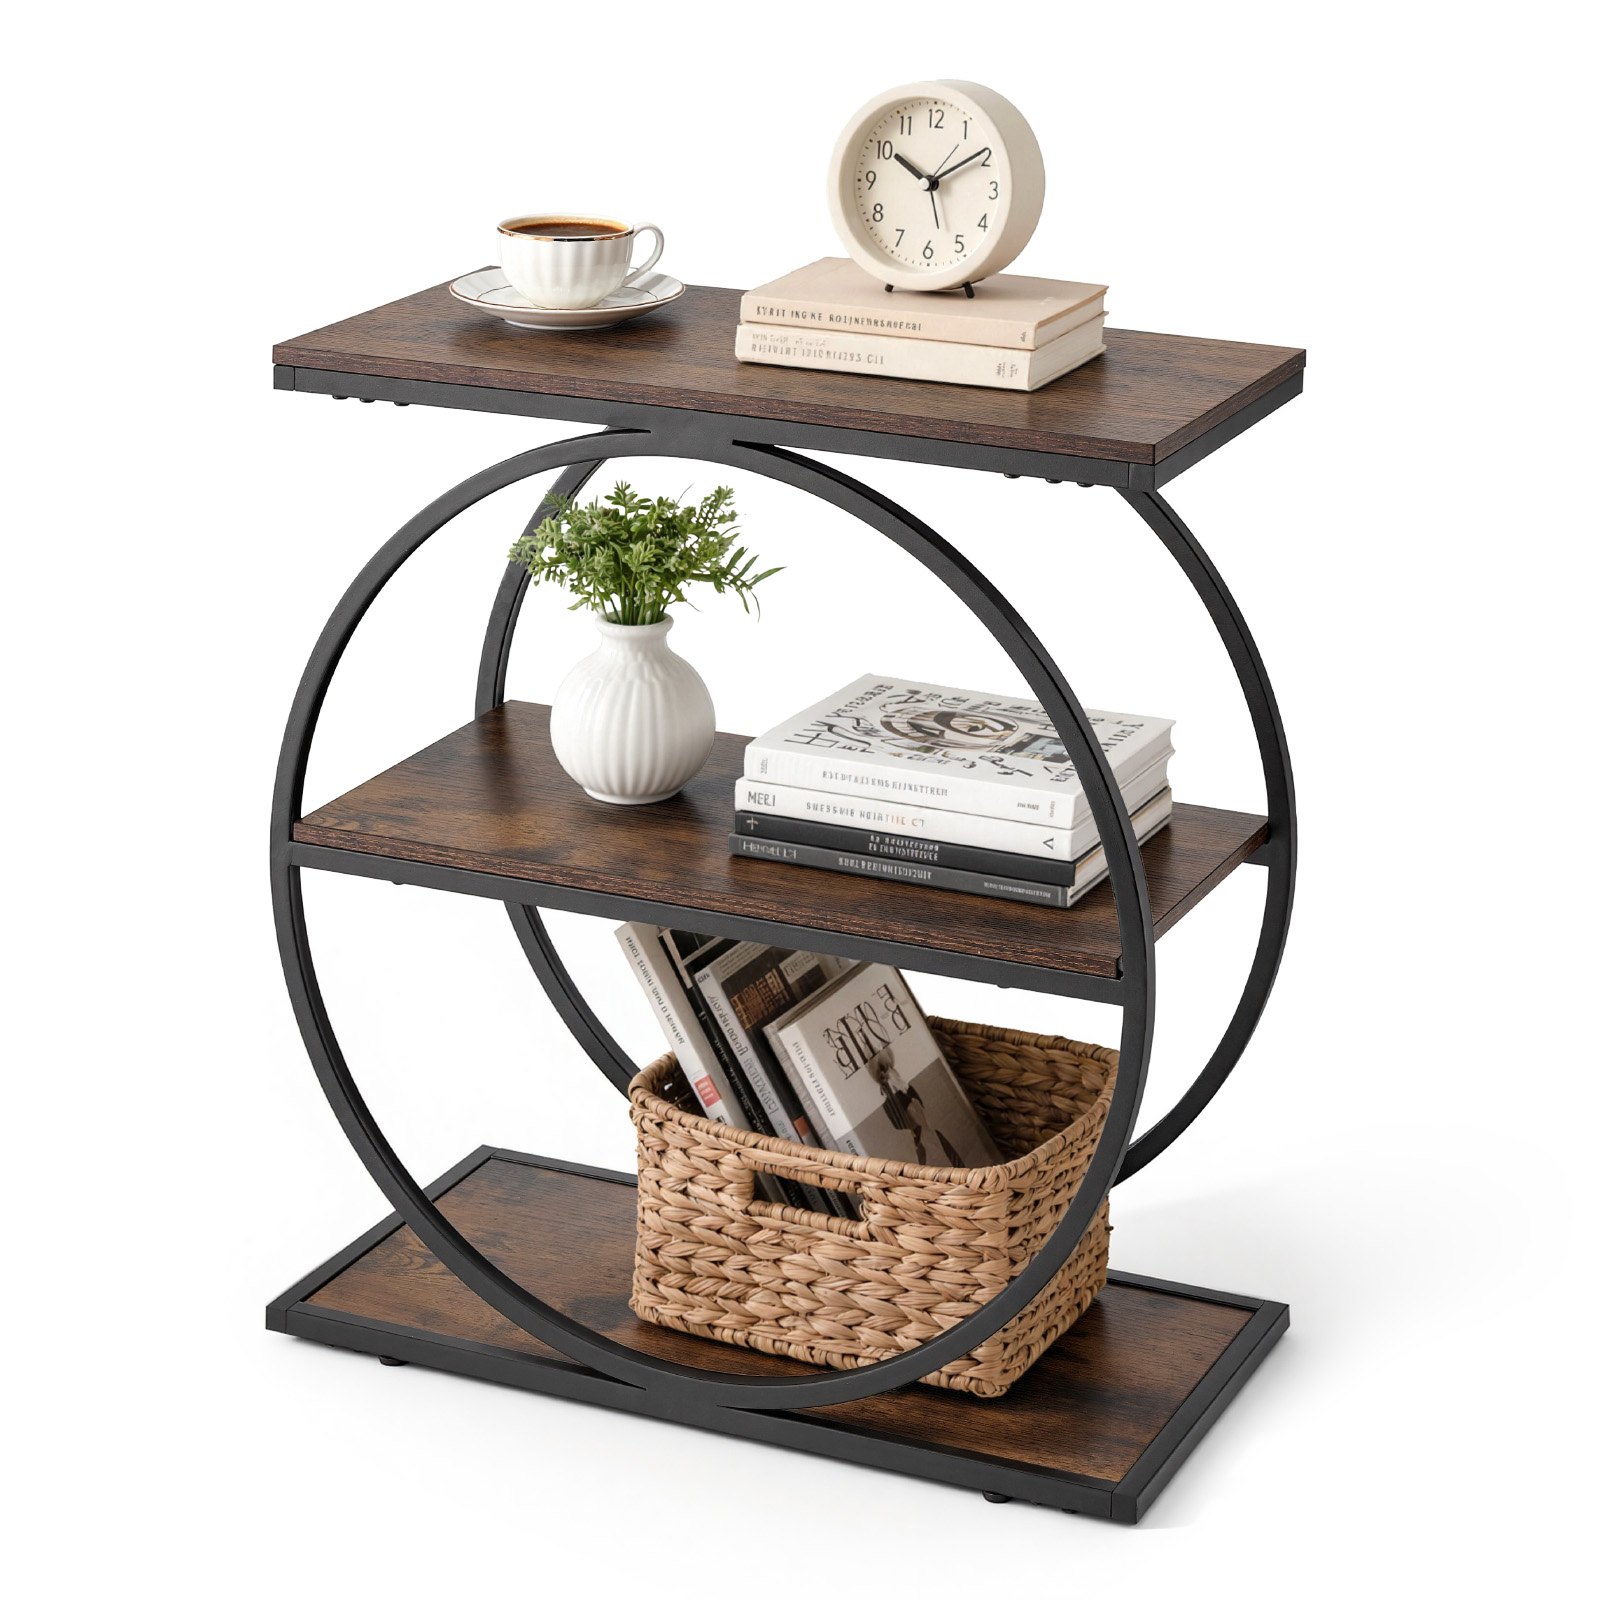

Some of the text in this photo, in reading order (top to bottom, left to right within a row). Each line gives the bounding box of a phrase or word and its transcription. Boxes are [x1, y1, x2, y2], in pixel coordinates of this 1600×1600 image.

[899, 115, 913, 136] 11
[928, 109, 945, 129] 12
[962, 120, 968, 140] 1
[876, 140, 893, 160] 10
[981, 148, 992, 167] 2
[865, 170, 877, 190] 9
[988, 181, 999, 200] 3
[872, 203, 884, 222] 8
[977, 213, 989, 232] 4
[895, 229, 905, 248] 7
[954, 234, 965, 253] 5
[922, 240, 934, 259] 6
